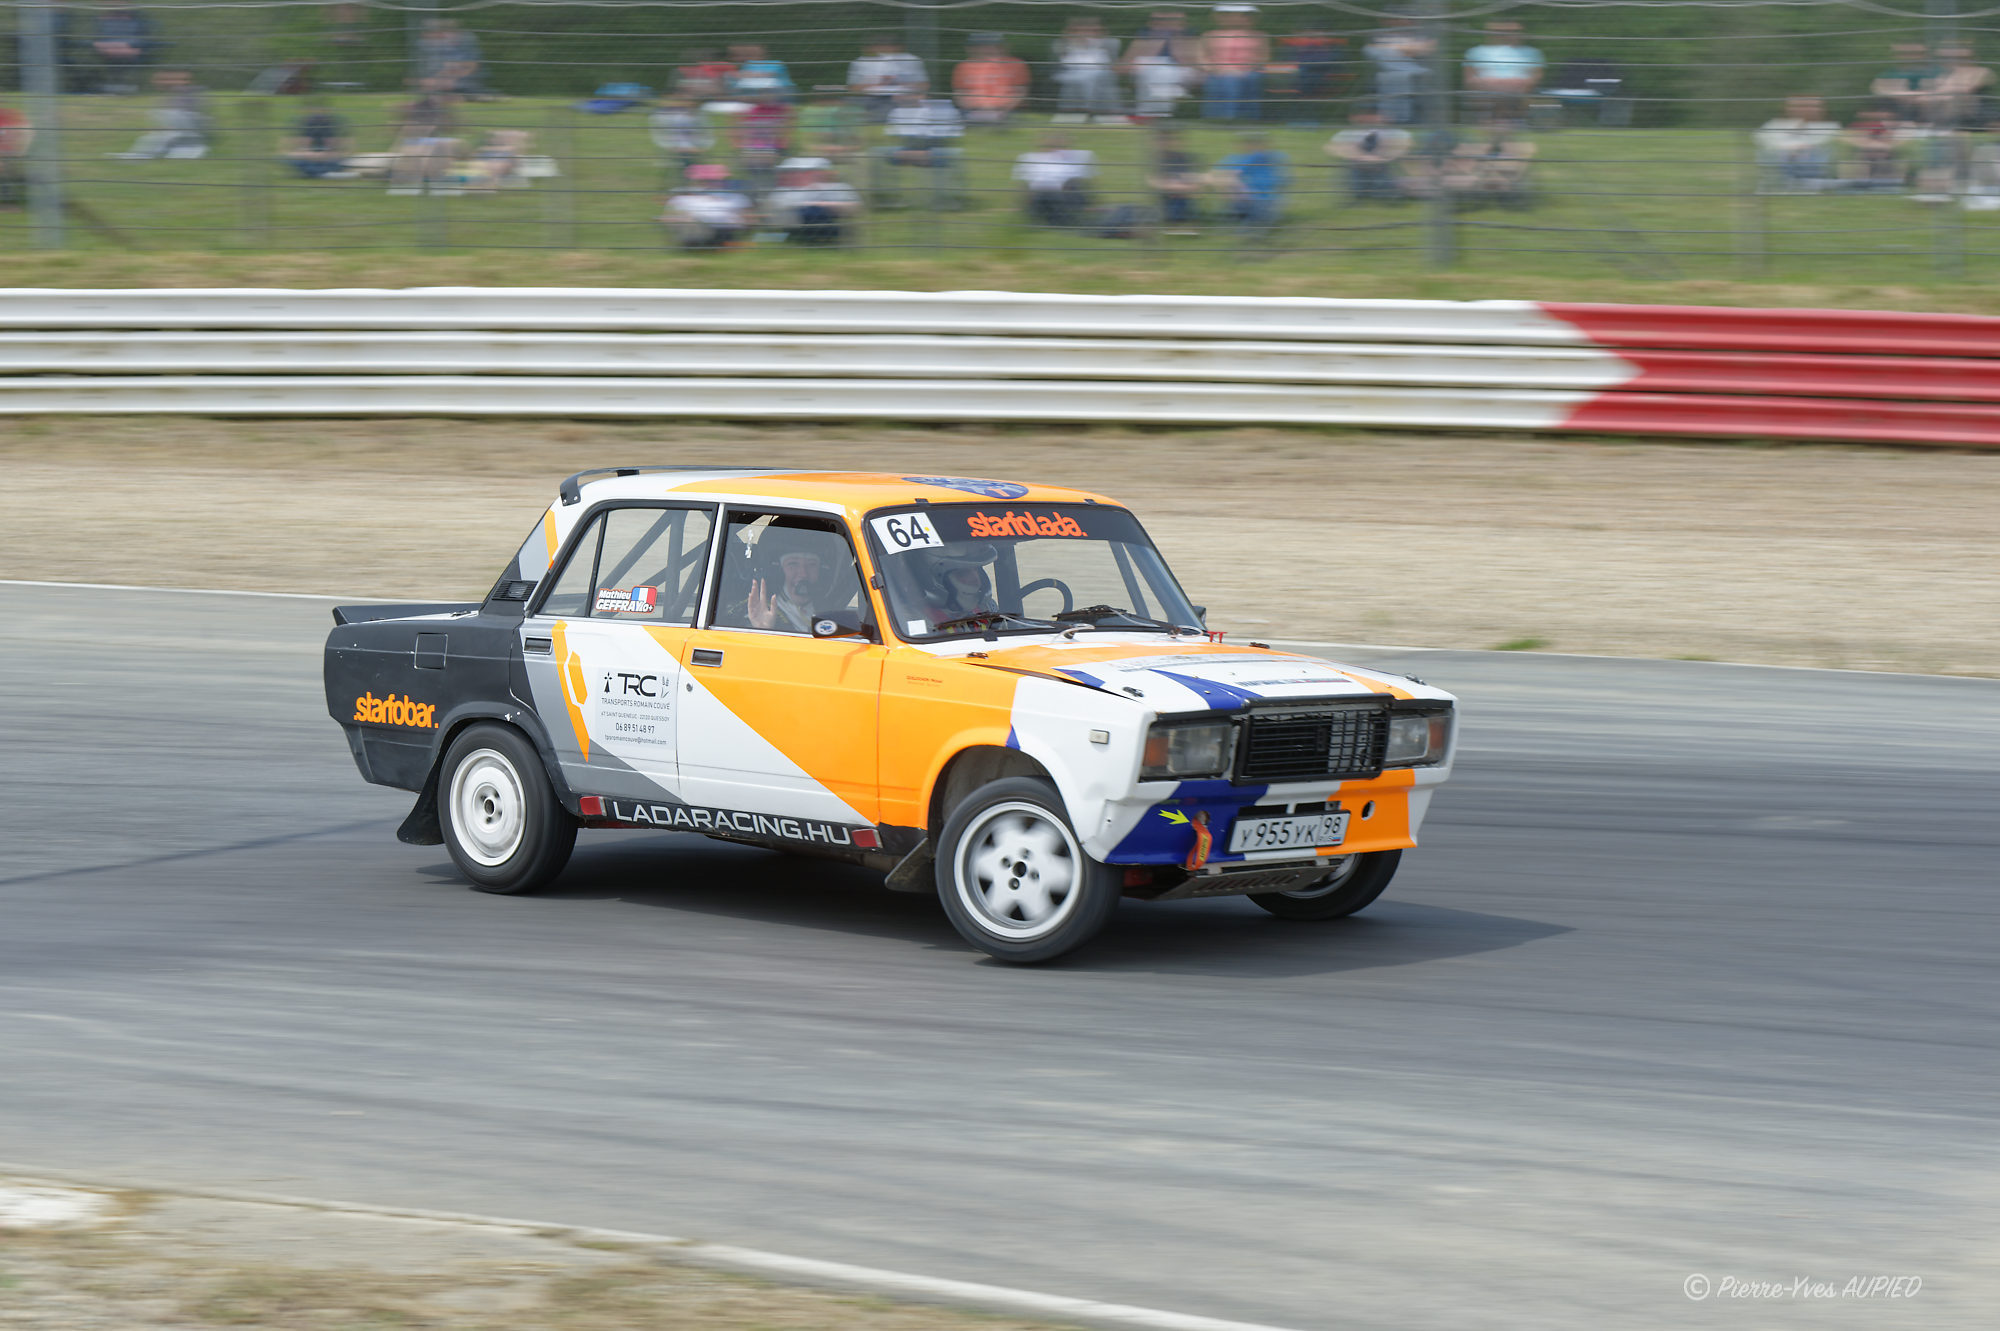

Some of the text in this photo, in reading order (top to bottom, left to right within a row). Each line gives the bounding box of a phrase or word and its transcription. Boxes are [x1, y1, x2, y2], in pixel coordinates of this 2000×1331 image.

[886, 515, 930, 547] 64
[598, 590, 632, 599] Mathieu
[617, 672, 657, 697] TRC
[601, 697, 633, 707] TRANSPORTS
[633, 701, 653, 709] ROMAIN
[615, 722, 655, 734] 06 89 51 48 97
[613, 801, 850, 845] LADARACING.HU
[1323, 816, 1341, 835] 98
